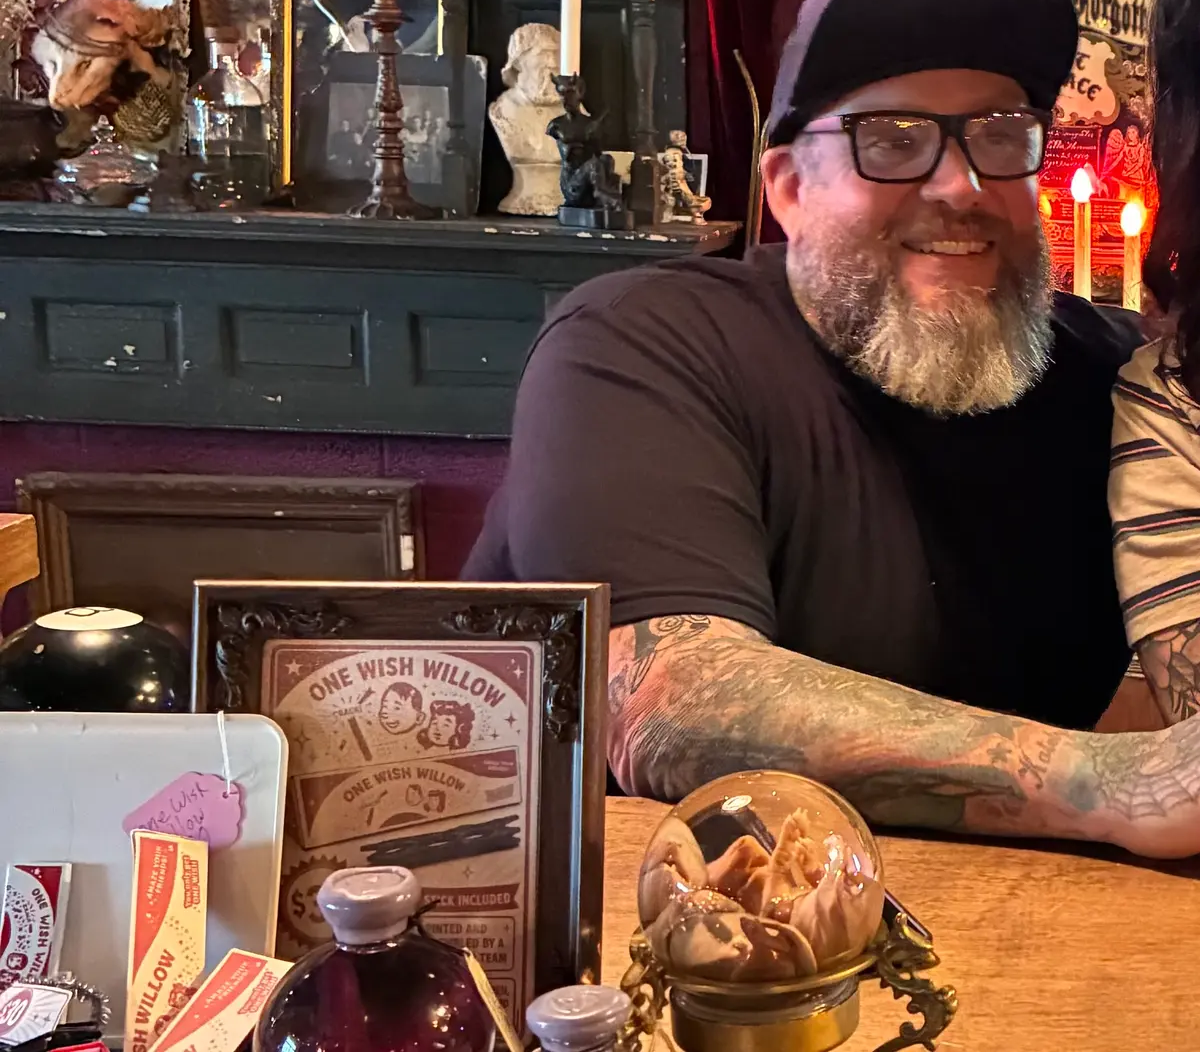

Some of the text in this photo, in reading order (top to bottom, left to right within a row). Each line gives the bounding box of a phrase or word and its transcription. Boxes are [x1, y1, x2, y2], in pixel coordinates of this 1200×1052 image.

[308, 656, 506, 708] ONE WISH WILLOW
[343, 767, 466, 803] ONE WISH WILLOW
[458, 892, 511, 907] INCLUDED
[26, 887, 51, 978] ONE WISH WIL
[465, 923, 488, 933] AND
[483, 938, 496, 948] BY
[480, 953, 507, 964] TEAM
[135, 949, 176, 1027] WILLOW
